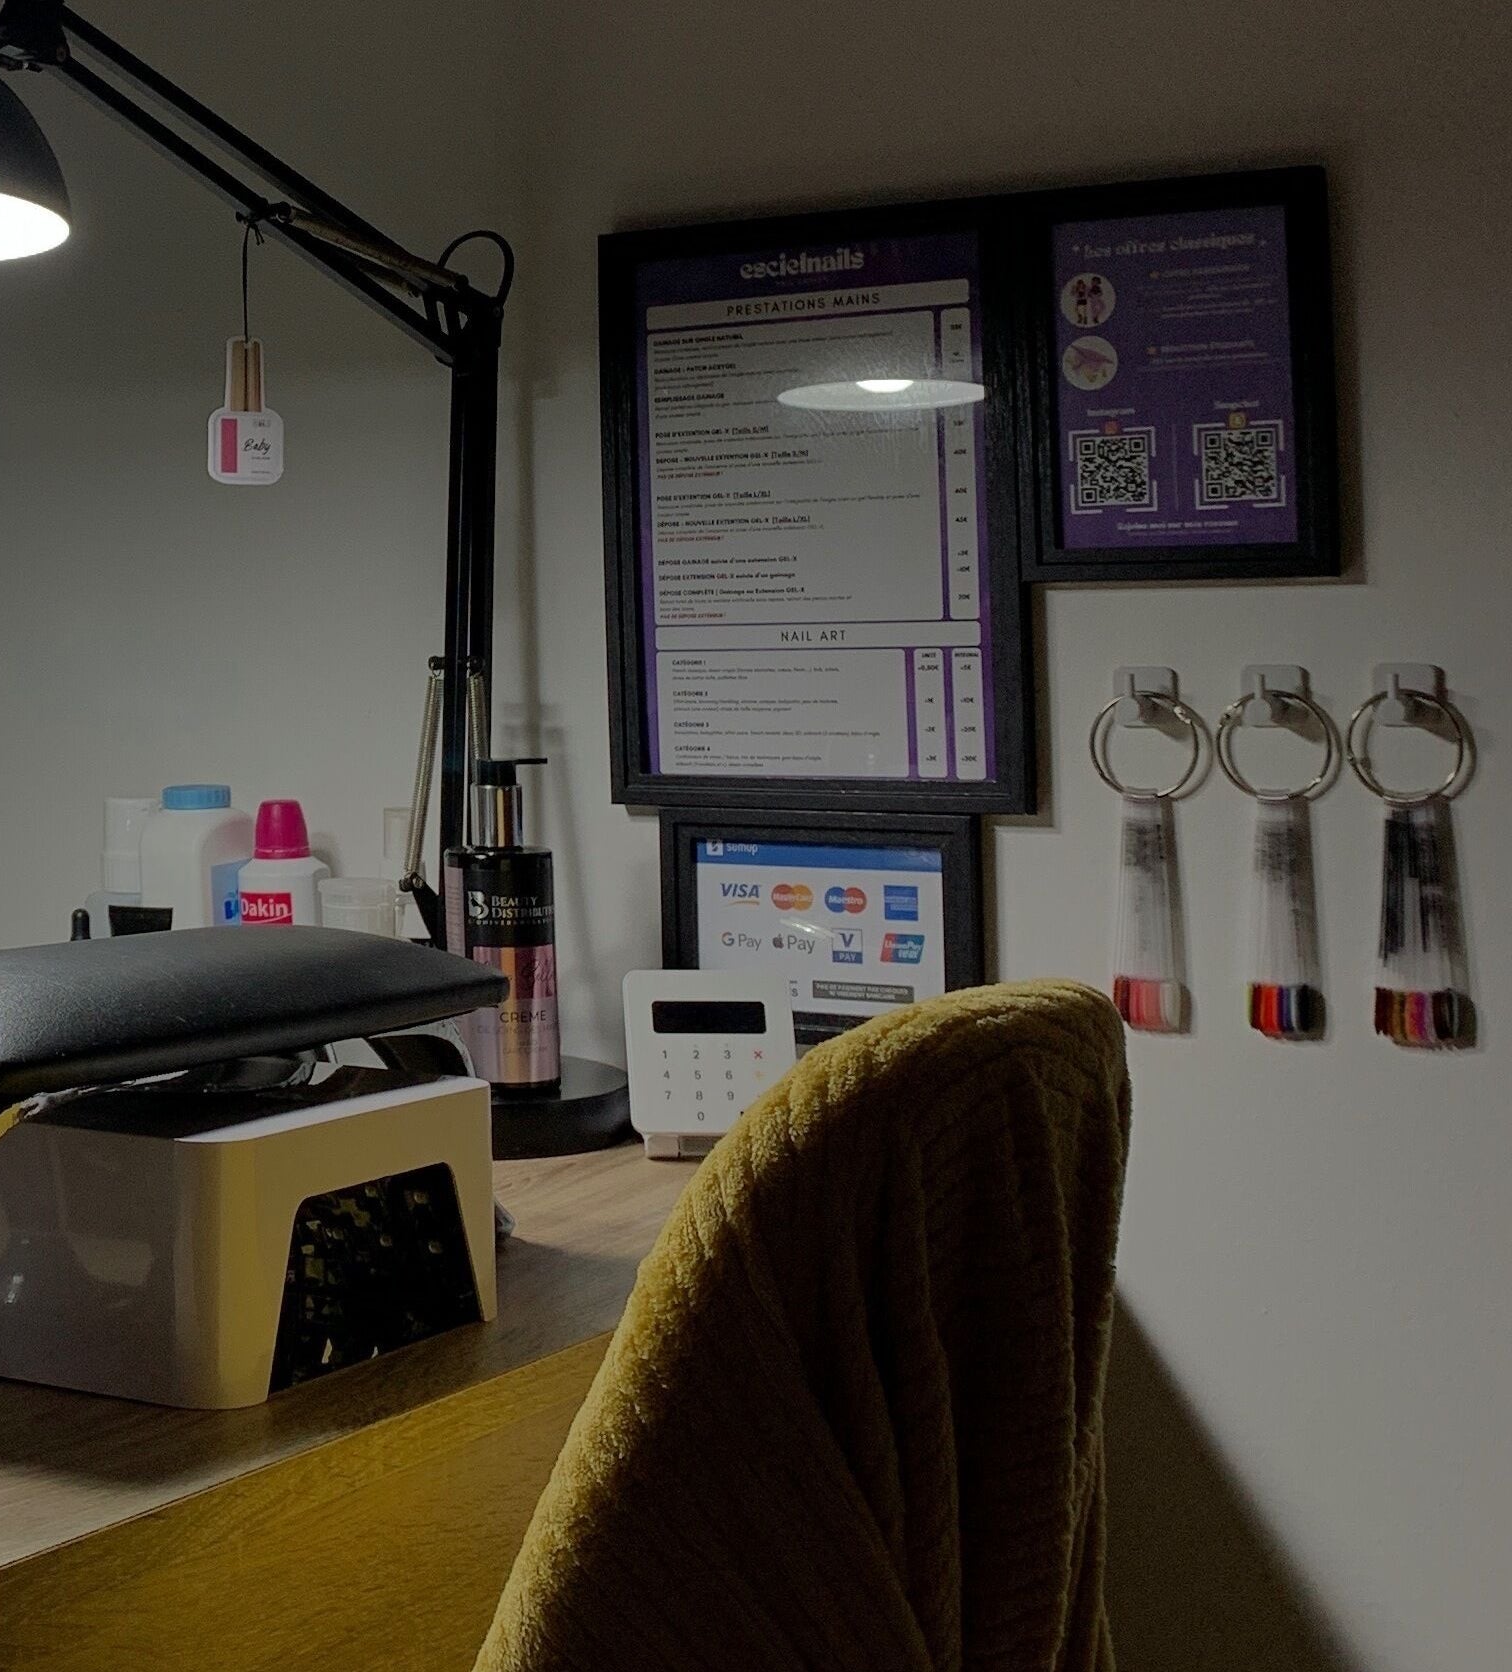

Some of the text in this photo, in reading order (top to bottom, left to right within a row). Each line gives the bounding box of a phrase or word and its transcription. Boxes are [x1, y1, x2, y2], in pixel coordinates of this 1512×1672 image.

[728, 293, 881, 316] PRESTATIONS MAINS
[781, 630, 847, 642] NAIL ART
[720, 883, 760, 898] VISA
[829, 894, 865, 904] Maestro
[240, 898, 288, 917] Dakin
[721, 931, 762, 951] G Pay
[787, 934, 816, 954] Pay
[840, 933, 854, 948] V
[839, 953, 857, 962] PAY
[662, 1049, 731, 1060] 1 2 3
[663, 1069, 733, 1080] 4 5 6
[665, 1090, 734, 1101] 7 8 9
[697, 1111, 705, 1121] 0
